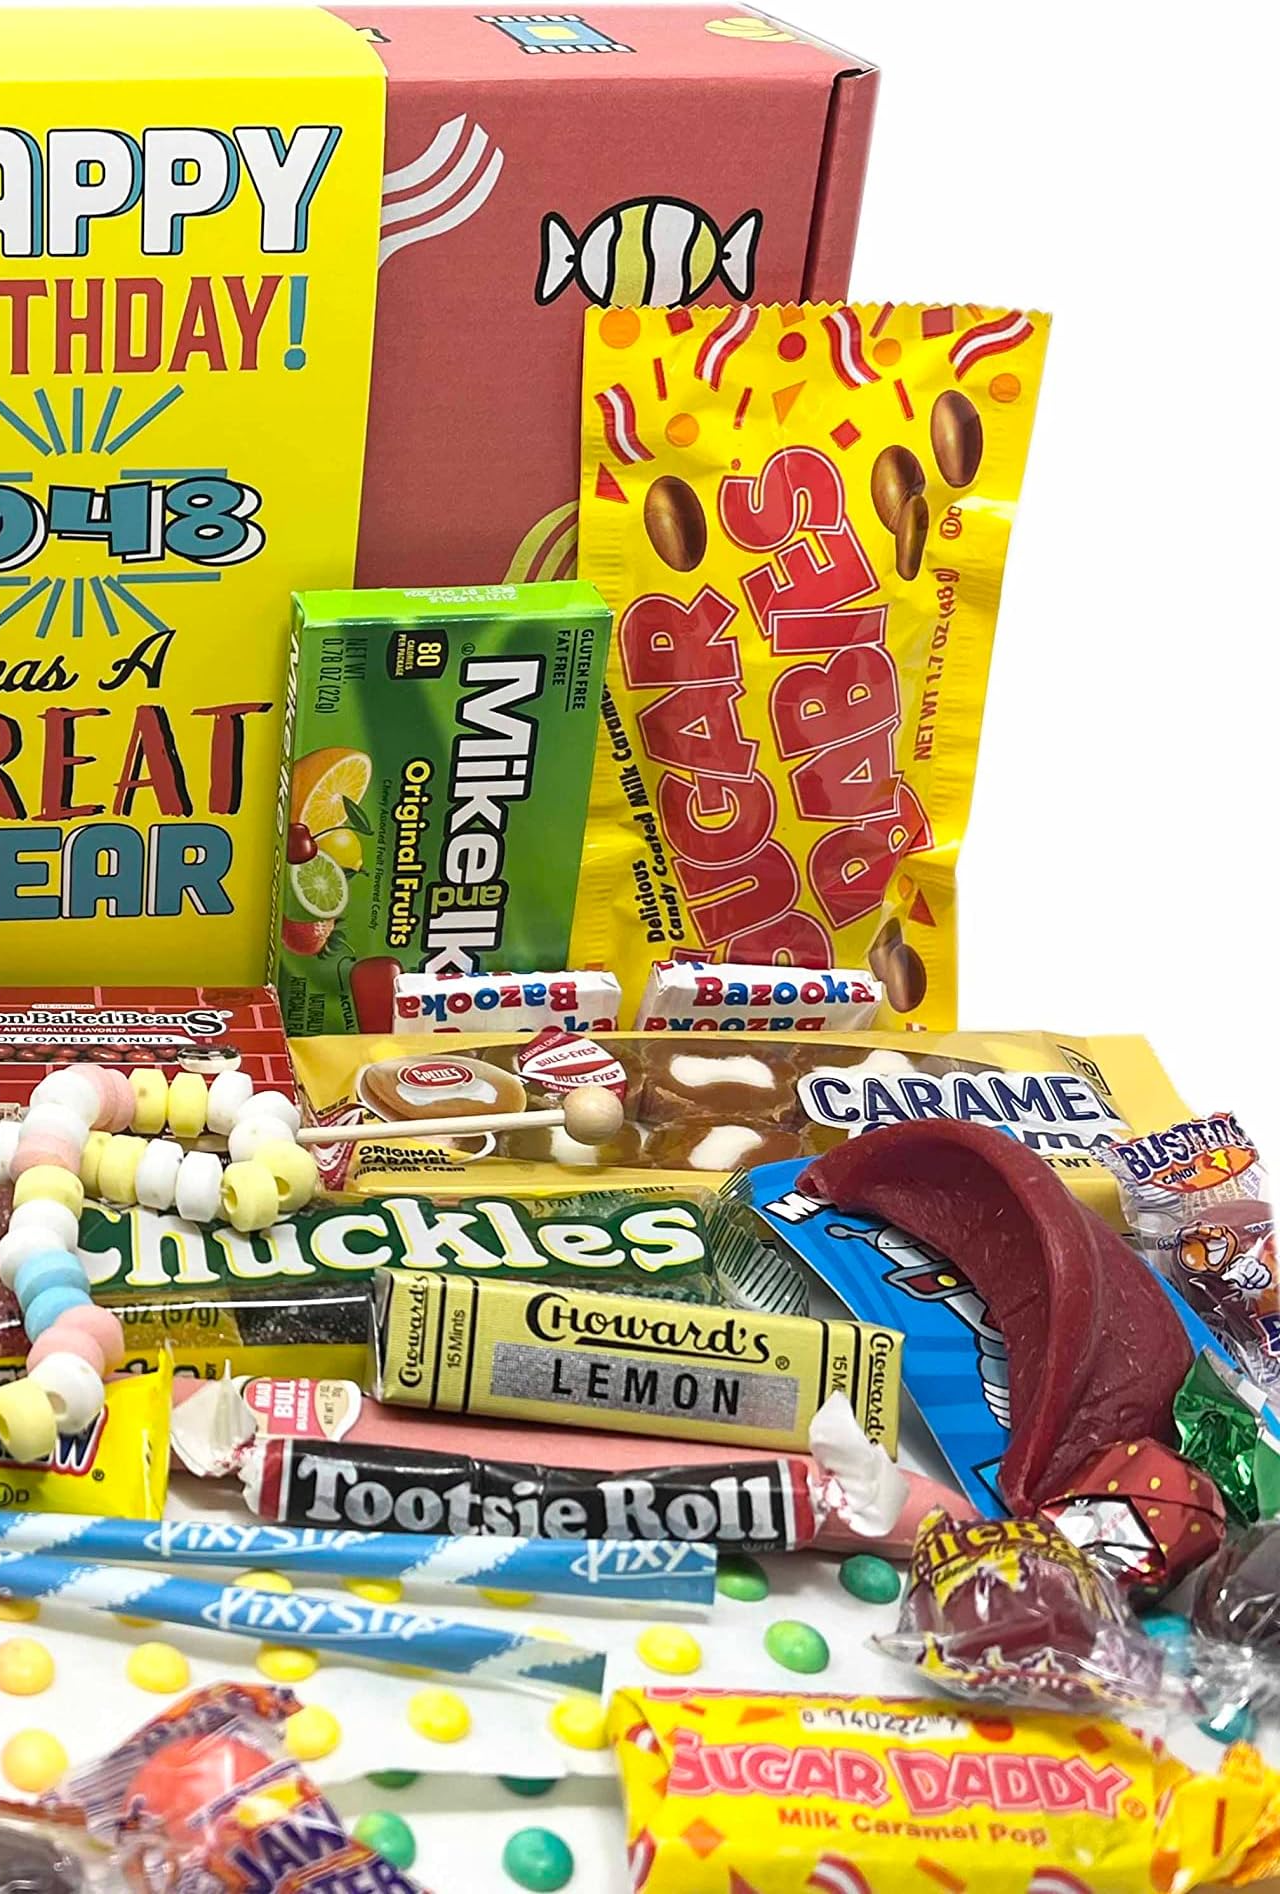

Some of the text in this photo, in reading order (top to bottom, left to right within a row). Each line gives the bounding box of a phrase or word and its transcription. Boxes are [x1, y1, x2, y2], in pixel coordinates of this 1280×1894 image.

[98, 630, 177, 692] A
[404, 640, 415, 671] CALORIES
[416, 641, 442, 667] 80
[552, 629, 571, 687] FAT FREE
[572, 628, 594, 712] GLUTEN FREE
[314, 638, 344, 714] 0.78 OZ (22g)
[720, 445, 934, 929] BABIES
[913, 620, 950, 762] NET WT 1.7 OZ
[446, 659, 542, 882] Mike
[389, 760, 431, 945] Original Fruits
[619, 764, 685, 941] Candy Coated Milk
[431, 885, 502, 914] and
[632, 859, 666, 943] Delicious
[396, 980, 579, 1021] Bazooka
[693, 975, 876, 1007] Bazooka
[3, 1026, 126, 1034] ARTIFICIALLY FLAVORED
[32, 1011, 114, 1025] Baked
[339, 993, 354, 1031] ACTUAL
[24, 1036, 90, 1044] COATED
[96, 1036, 174, 1044] PEANUTS
[359, 1146, 450, 1158] ORIGINAL
[360, 1156, 452, 1166] CARAMEL
[391, 1165, 466, 1173] With Cream
[1161, 1164, 1198, 1185] CANDY
[547, 1184, 677, 1209] FAT FREE CANDY
[77, 1196, 705, 1287] Chuckles
[447, 1309, 466, 1370] 15 Mints
[833, 1356, 847, 1371] 15
[551, 1358, 742, 1416] LEMON
[297, 1453, 778, 1544] Tootsie Roll
[668, 1727, 1130, 1819] SUGAR DADDY
[778, 1807, 1048, 1847] Milk Caramel Pop
